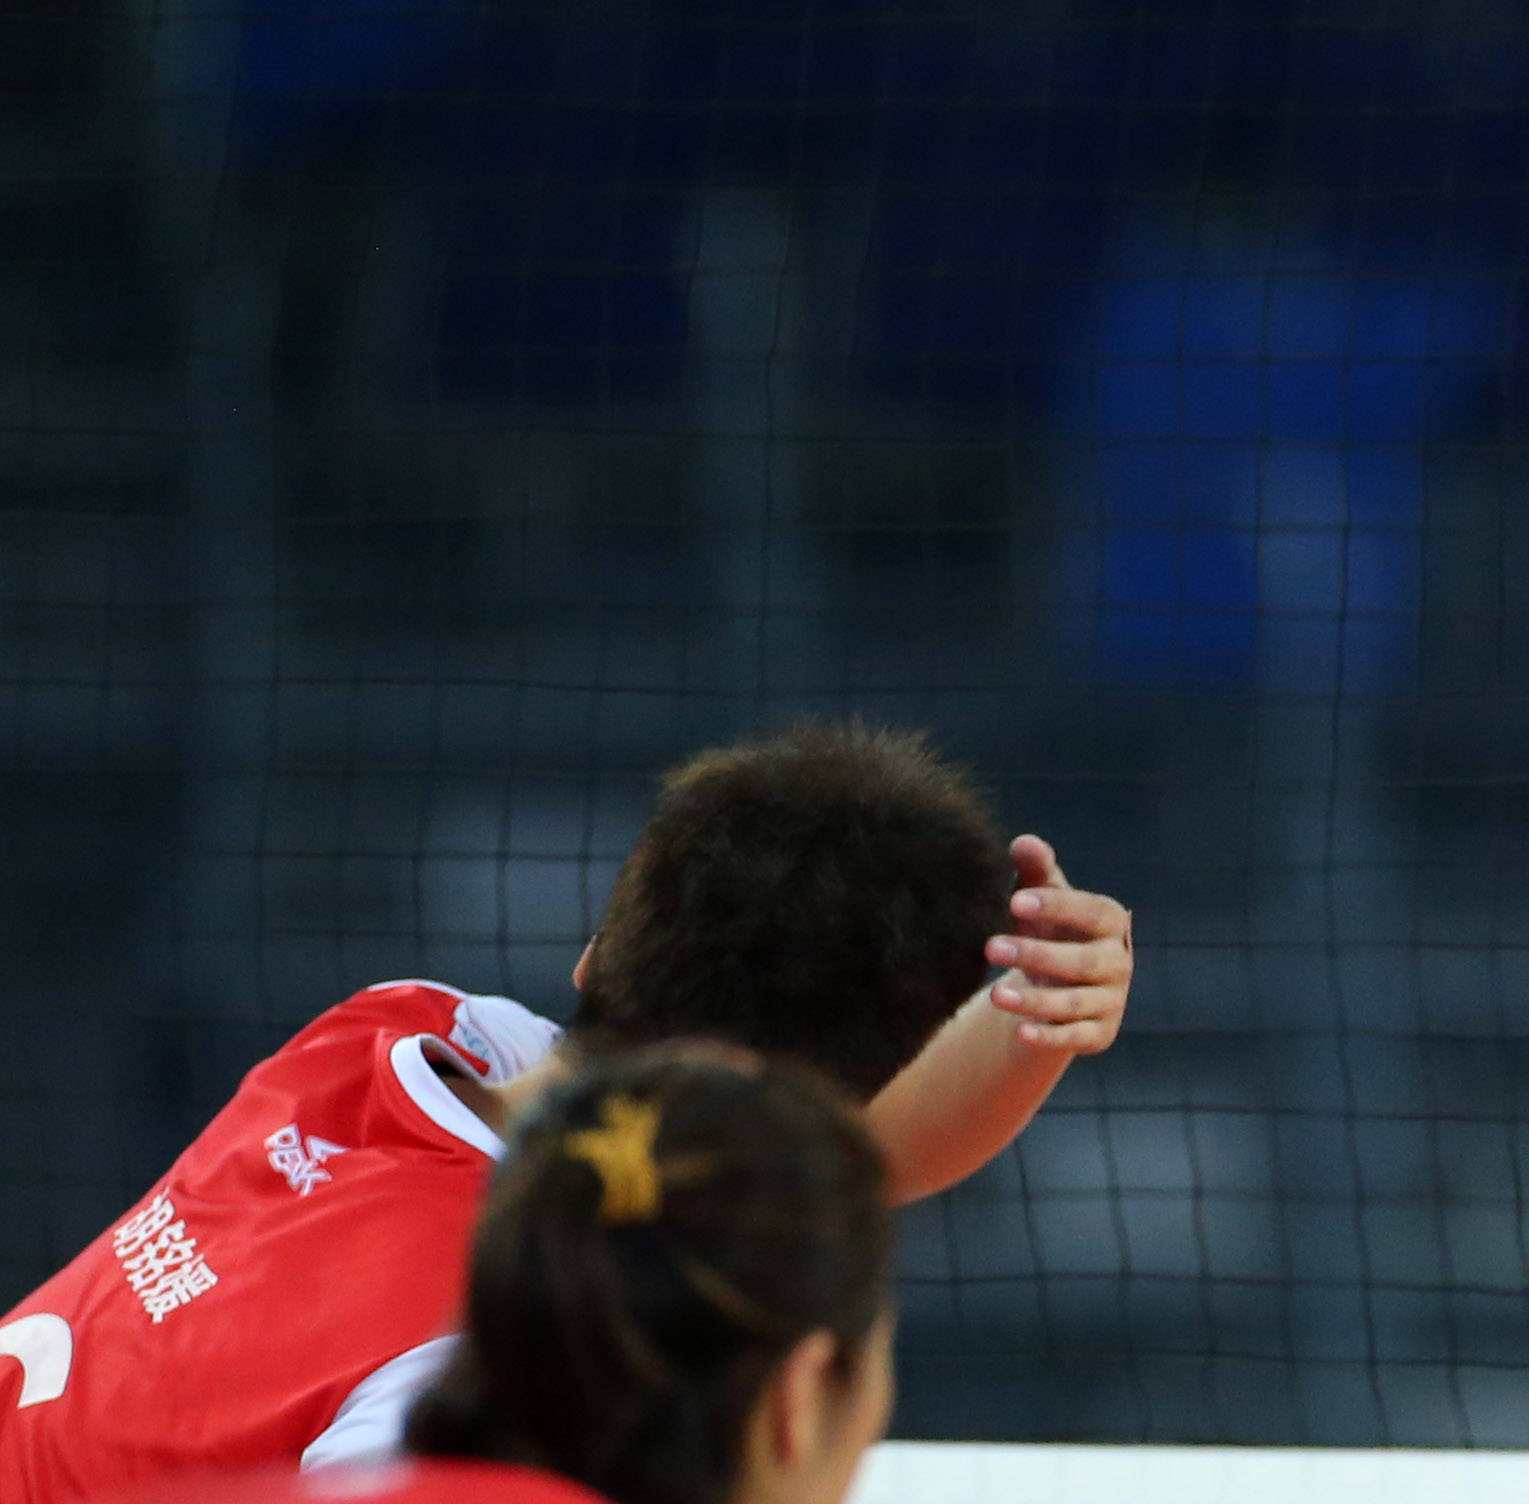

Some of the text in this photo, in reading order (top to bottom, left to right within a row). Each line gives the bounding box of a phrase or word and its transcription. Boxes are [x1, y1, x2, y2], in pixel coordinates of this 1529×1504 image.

[263, 1122, 333, 1197] PEAK
[112, 1186, 219, 1324] 胡铭媛
